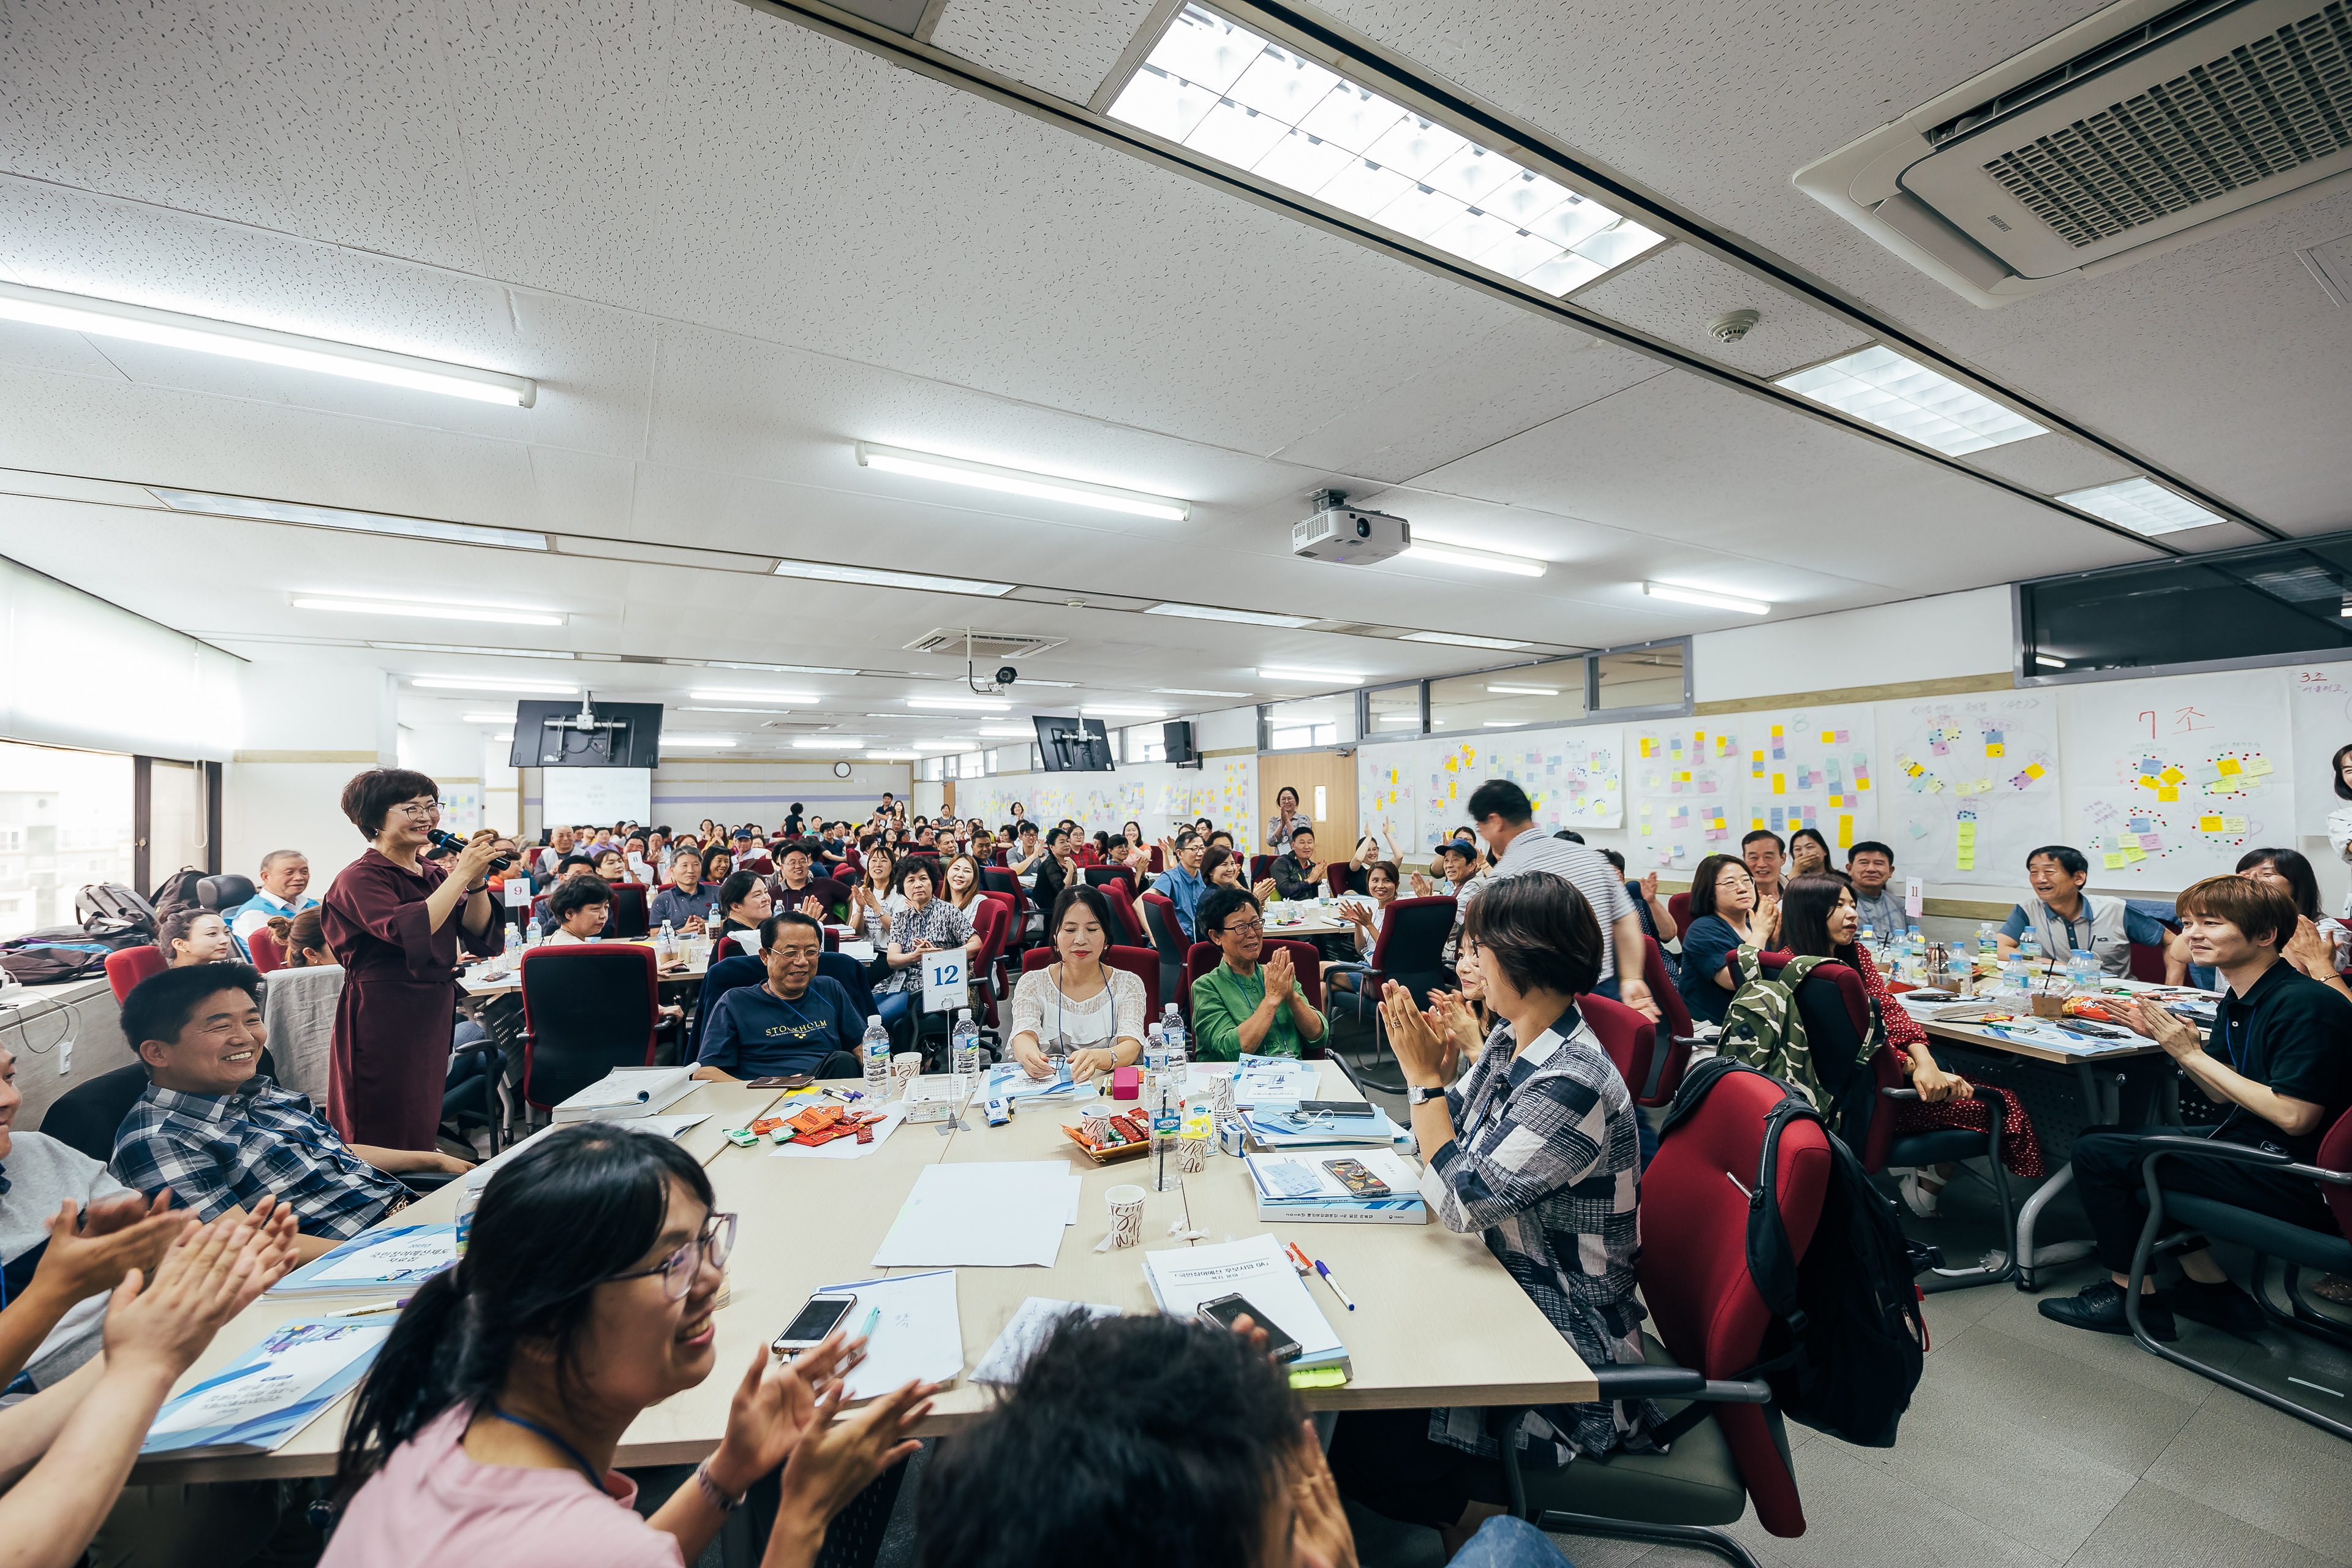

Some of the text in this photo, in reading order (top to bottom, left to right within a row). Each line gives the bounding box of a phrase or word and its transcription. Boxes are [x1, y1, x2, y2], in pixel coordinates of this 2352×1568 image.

[1987, 214, 2012, 232] SAMSUNG
[1792, 714, 1809, 733] 8
[514, 886, 522, 895] 9
[1912, 886, 1918, 897] 11
[933, 965, 959, 987] 12
[370, 1248, 451, 1259] 국민참여예산제도
